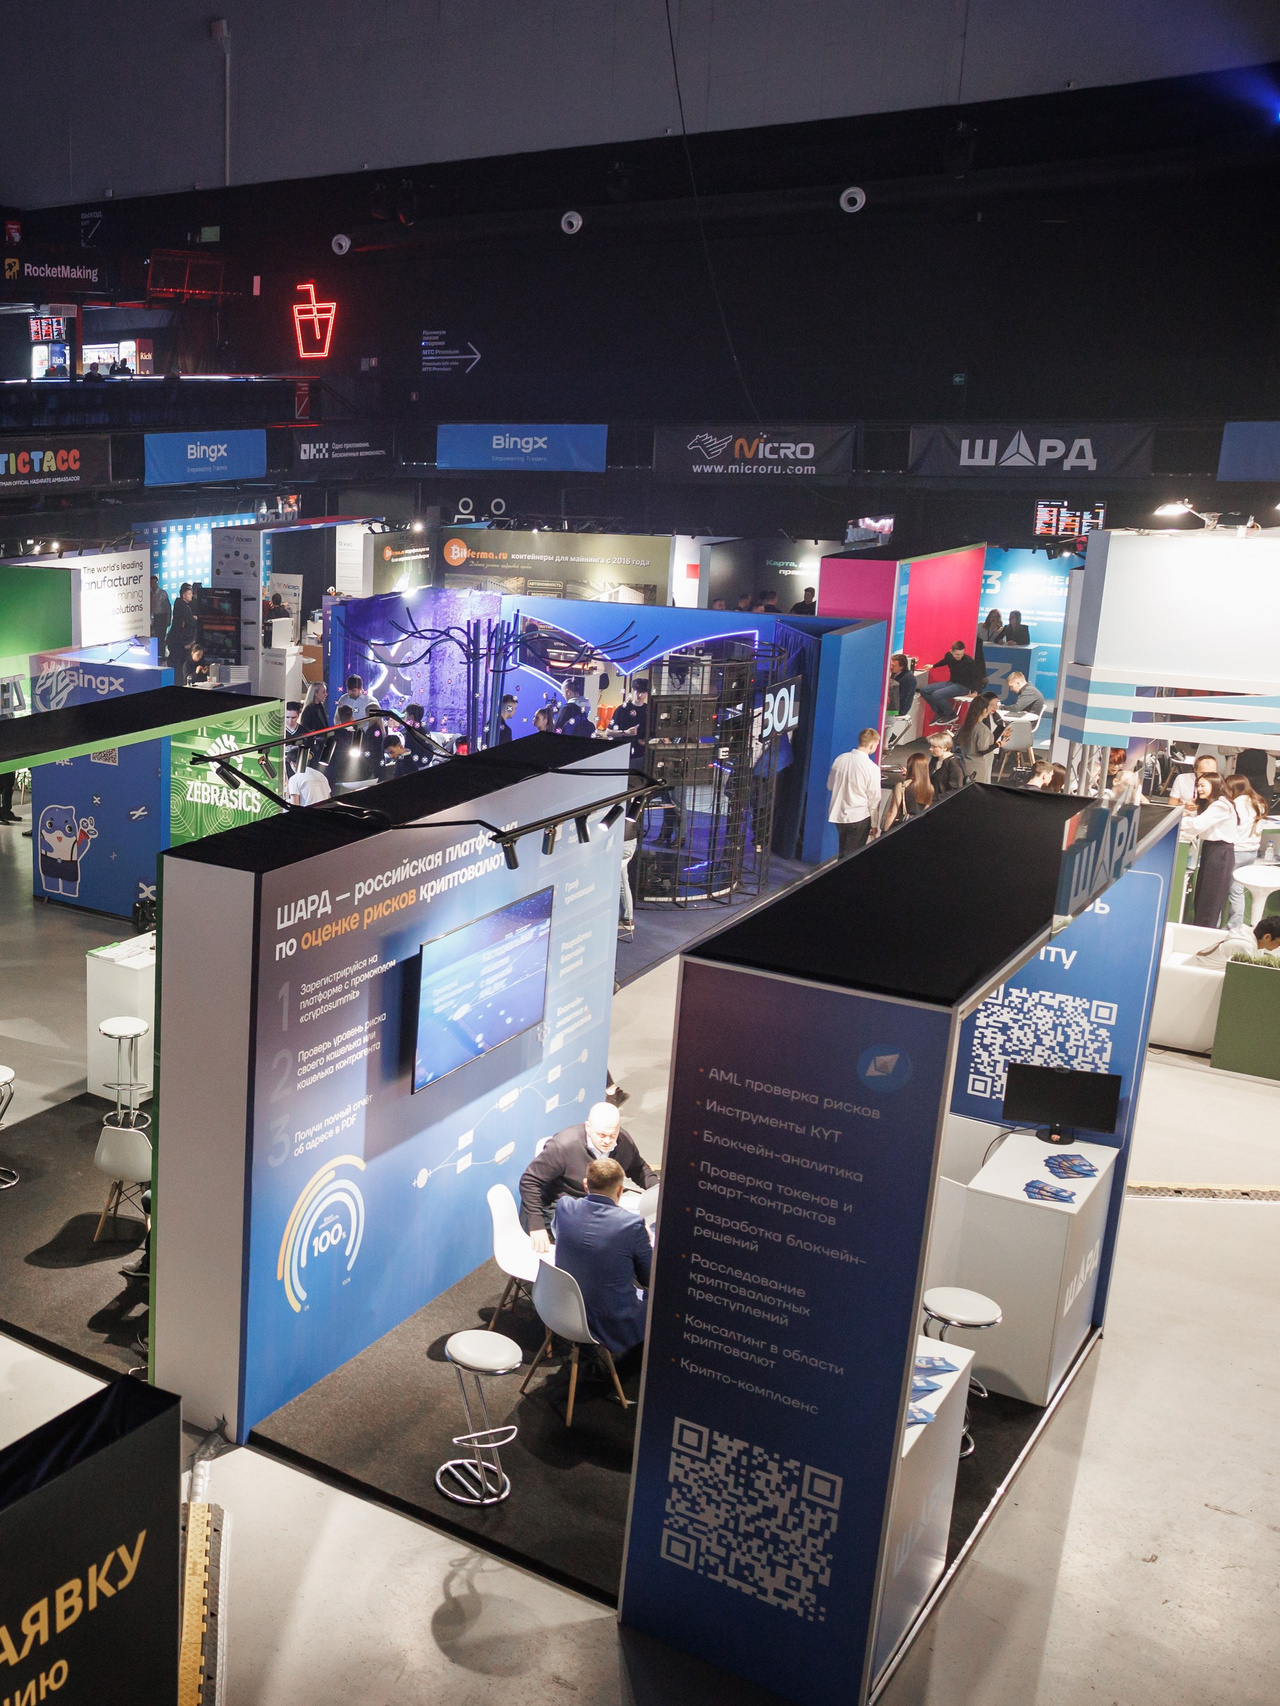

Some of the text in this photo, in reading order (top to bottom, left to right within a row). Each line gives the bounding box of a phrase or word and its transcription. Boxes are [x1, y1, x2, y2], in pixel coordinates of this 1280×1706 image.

[24, 263, 99, 282] RocketMaking
[300, 442, 329, 460] OKX
[692, 462, 816, 475] www.microru.com
[959, 429, 1098, 471] ШАРД
[83, 560, 144, 575] The world's leading
[511, 552, 650, 566] контейнеры для майнинга 2016 года
[82, 573, 144, 591] anufacturer
[111, 602, 144, 616] solutions
[186, 780, 261, 813] ZEBRASICS
[275, 850, 506, 962] по оценке рисков криптовалют
[276, 852, 443, 931] ШАРД российская
[299, 958, 397, 1011] платформе промокодом
[300, 954, 378, 996] Зарегистрируйся на
[297, 1012, 387, 1064] Проверь уровень риска
[297, 1031, 376, 1077] своего кошелька или
[296, 1040, 381, 1091] кошелька контрагента
[708, 1068, 881, 1120] AML проверка рисков
[293, 1114, 358, 1157] об адресе PDF
[294, 1093, 373, 1144] Получи полный отчёт
[706, 1098, 842, 1143] Инструменты KYT
[703, 1130, 864, 1183] Блокчейн-аналитика
[698, 1179, 837, 1226] смарт-контрактов
[700, 1161, 839, 1209] Проверка токенов
[693, 1225, 759, 1252] решений
[695, 1207, 867, 1265] Разработка блокчейн-
[689, 1271, 811, 1316] криптовалютных
[691, 1253, 806, 1298] Расследование
[687, 1287, 789, 1326] преступлений
[683, 1331, 777, 1369] криптовалют
[685, 1313, 845, 1376] Консалтинг области
[680, 1357, 819, 1415] Крипто-комплаенс
